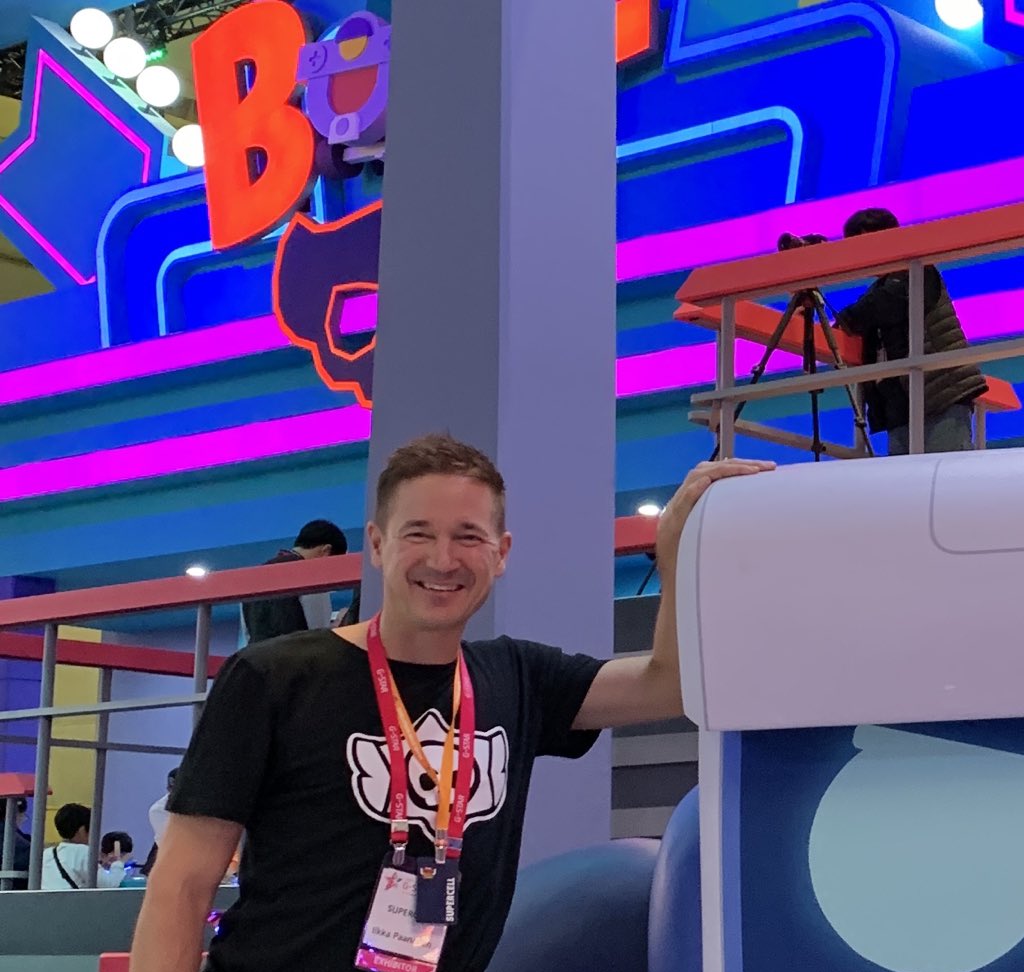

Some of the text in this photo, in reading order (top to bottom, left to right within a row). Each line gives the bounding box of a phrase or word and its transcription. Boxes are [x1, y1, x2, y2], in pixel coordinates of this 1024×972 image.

[388, 725, 400, 752] G-STAR
[462, 733, 471, 759] G-STAR
[395, 792, 404, 820] G-STA
[454, 794, 465, 823] G-STAR
[446, 878, 455, 922] SUPERCELL
[374, 956, 418, 972] EXHIBITOR
